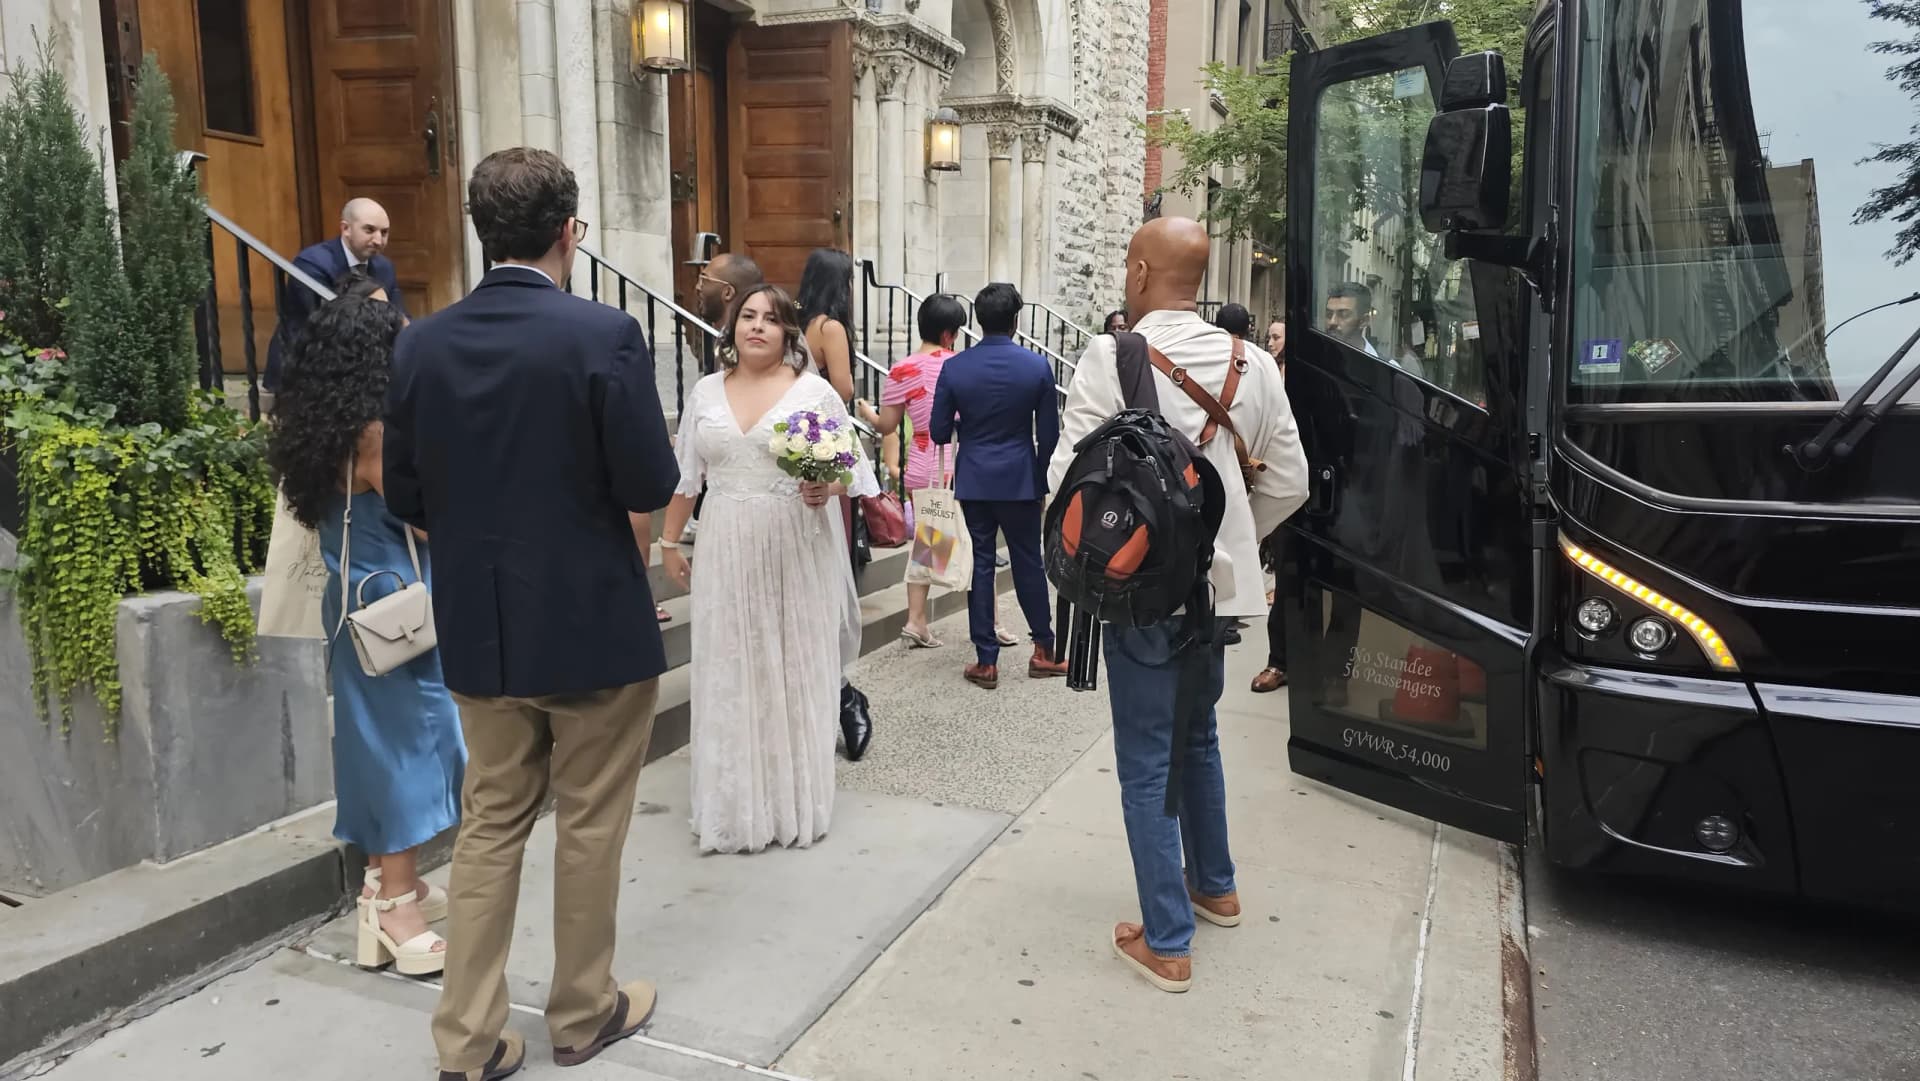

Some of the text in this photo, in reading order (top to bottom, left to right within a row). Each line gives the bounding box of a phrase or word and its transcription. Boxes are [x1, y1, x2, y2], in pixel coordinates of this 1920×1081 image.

[1343, 662, 1441, 698] 56 Passengers
[1349, 647, 1432, 677] No Standee
[1343, 728, 1450, 772] GVWR 54,000
